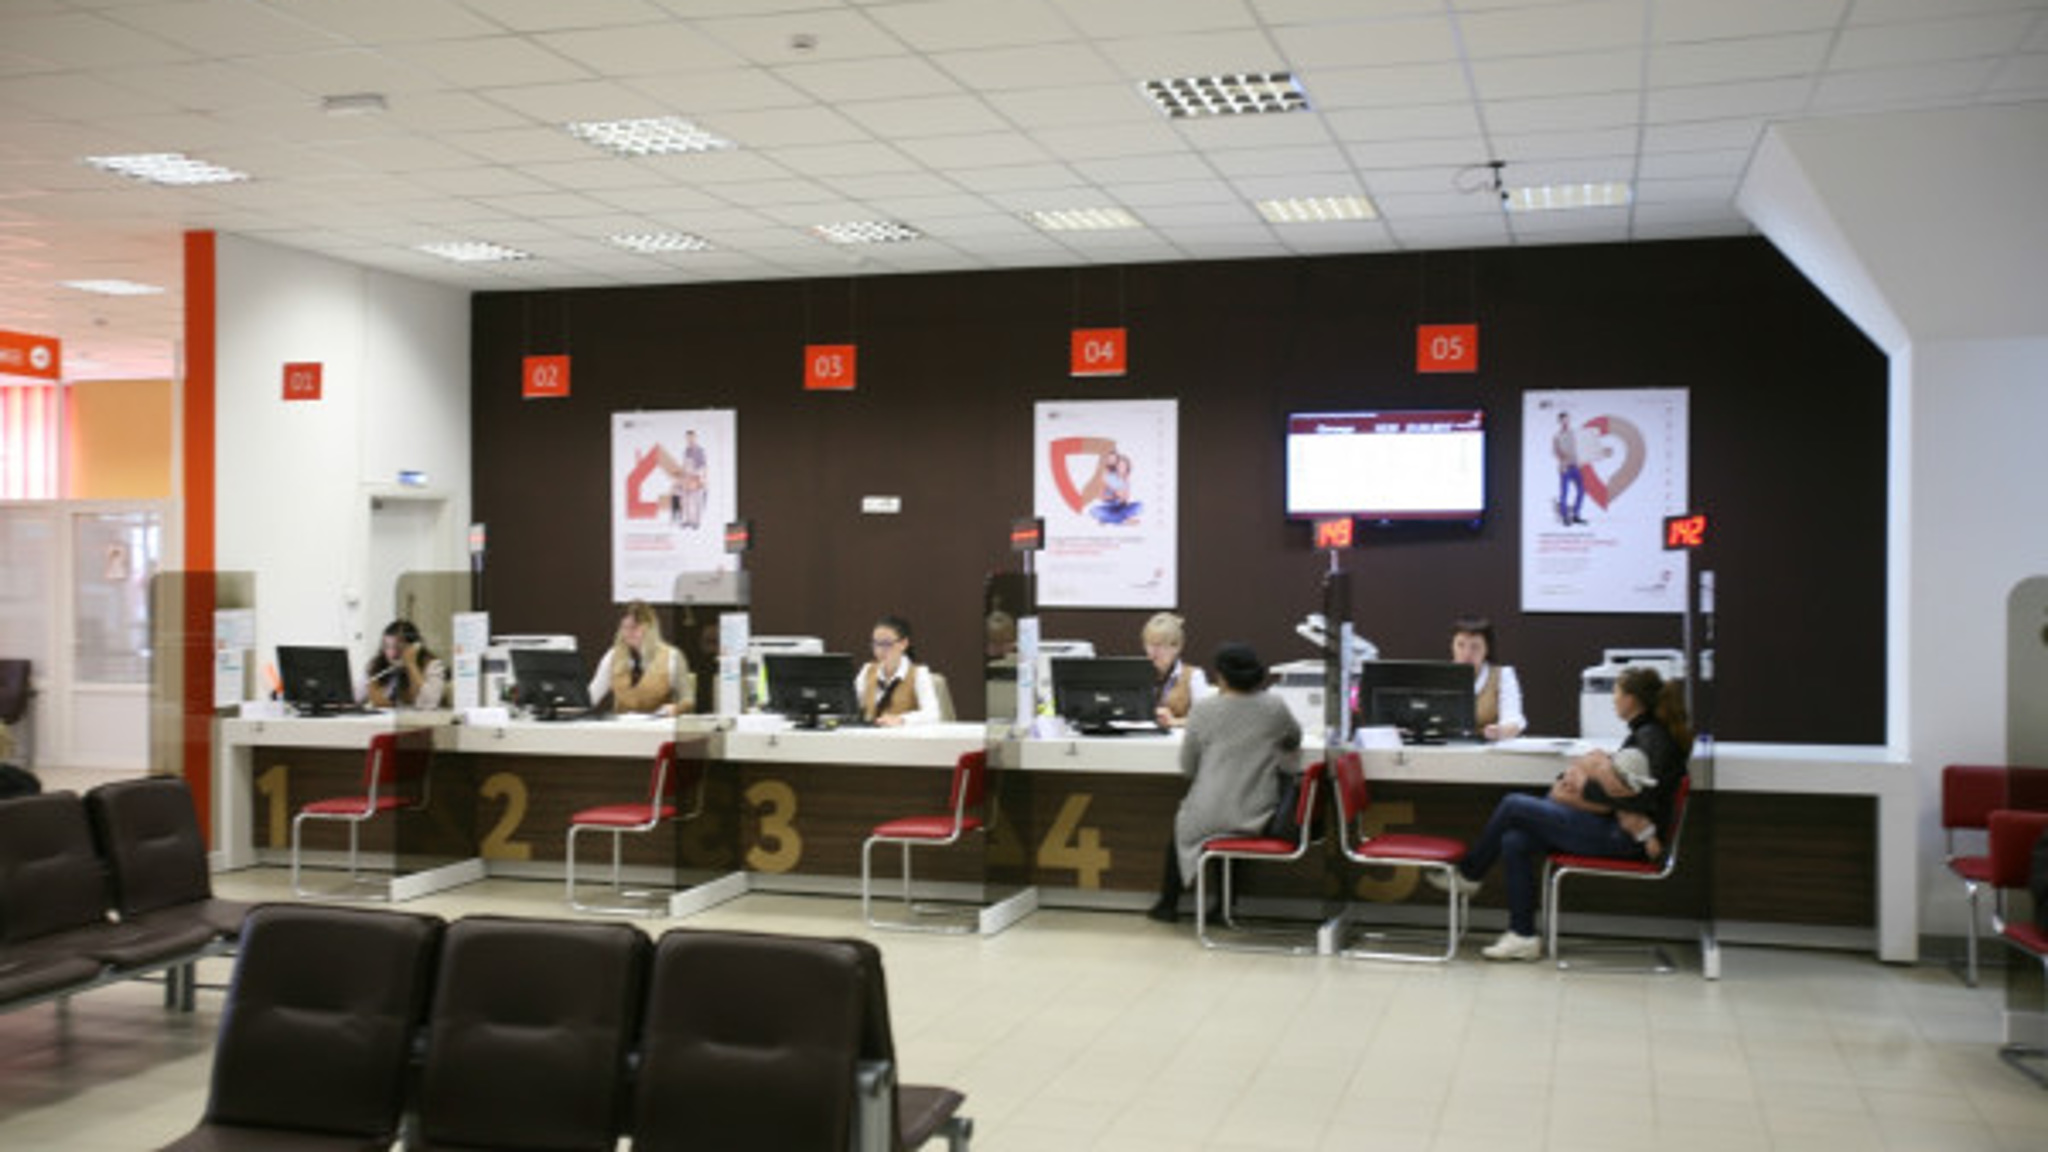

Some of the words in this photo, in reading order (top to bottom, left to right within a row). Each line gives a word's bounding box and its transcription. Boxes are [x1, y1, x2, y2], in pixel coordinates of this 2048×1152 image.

[1085, 341, 1113, 362] 04
[1432, 336, 1463, 359] 05
[291, 372, 314, 390] 01
[533, 365, 558, 386] 02
[815, 355, 842, 377] 03
[1669, 515, 1705, 546] 142
[257, 766, 287, 850] 1
[481, 773, 530, 860] 2
[745, 781, 801, 873] 3
[1037, 793, 1110, 889] 4
[1356, 802, 1418, 902] 5
